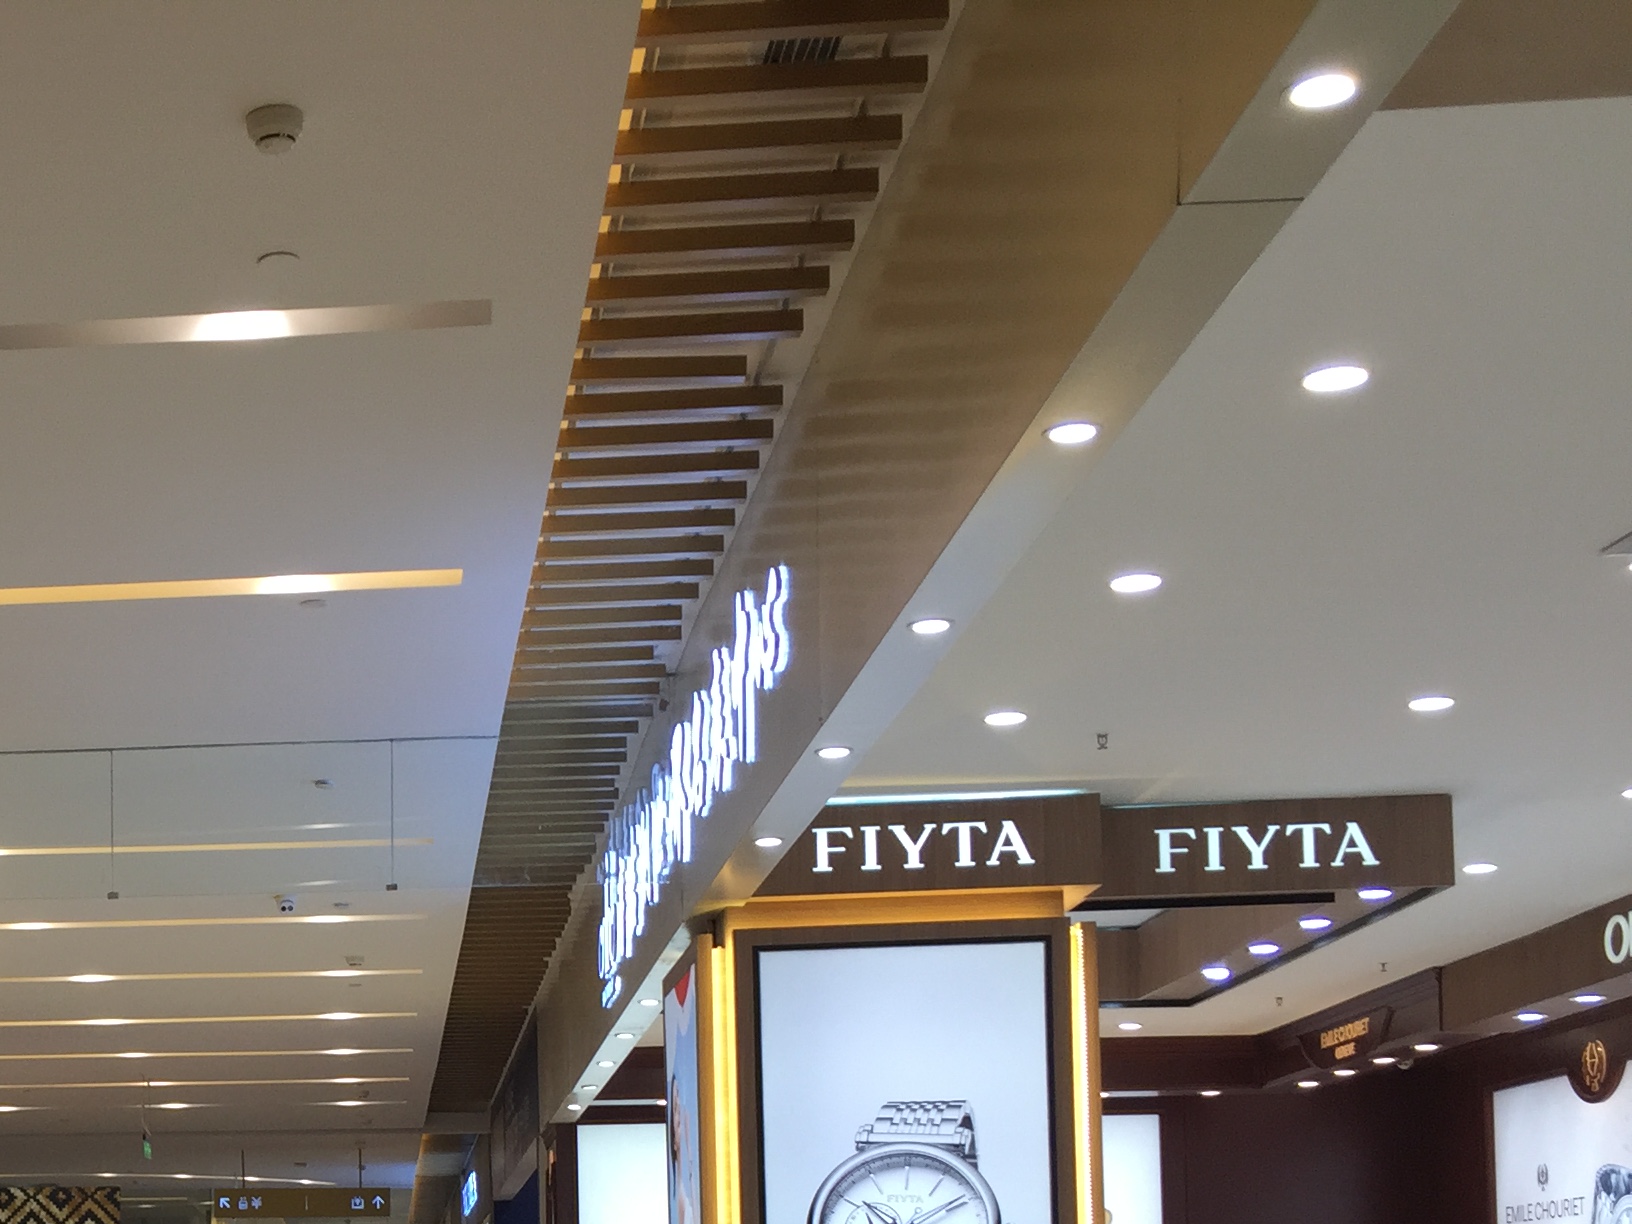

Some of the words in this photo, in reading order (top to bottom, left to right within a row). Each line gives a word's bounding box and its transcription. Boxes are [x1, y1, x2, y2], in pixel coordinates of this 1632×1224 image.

[811, 820, 1035, 873] FIYTA
[1154, 821, 1380, 874] FIYTA
[1604, 910, 1632, 964] O
[886, 1194, 924, 1204] FIYTA
[1506, 1203, 1533, 1224] EMILE
[1534, 1197, 1586, 1221] CHOURIET
